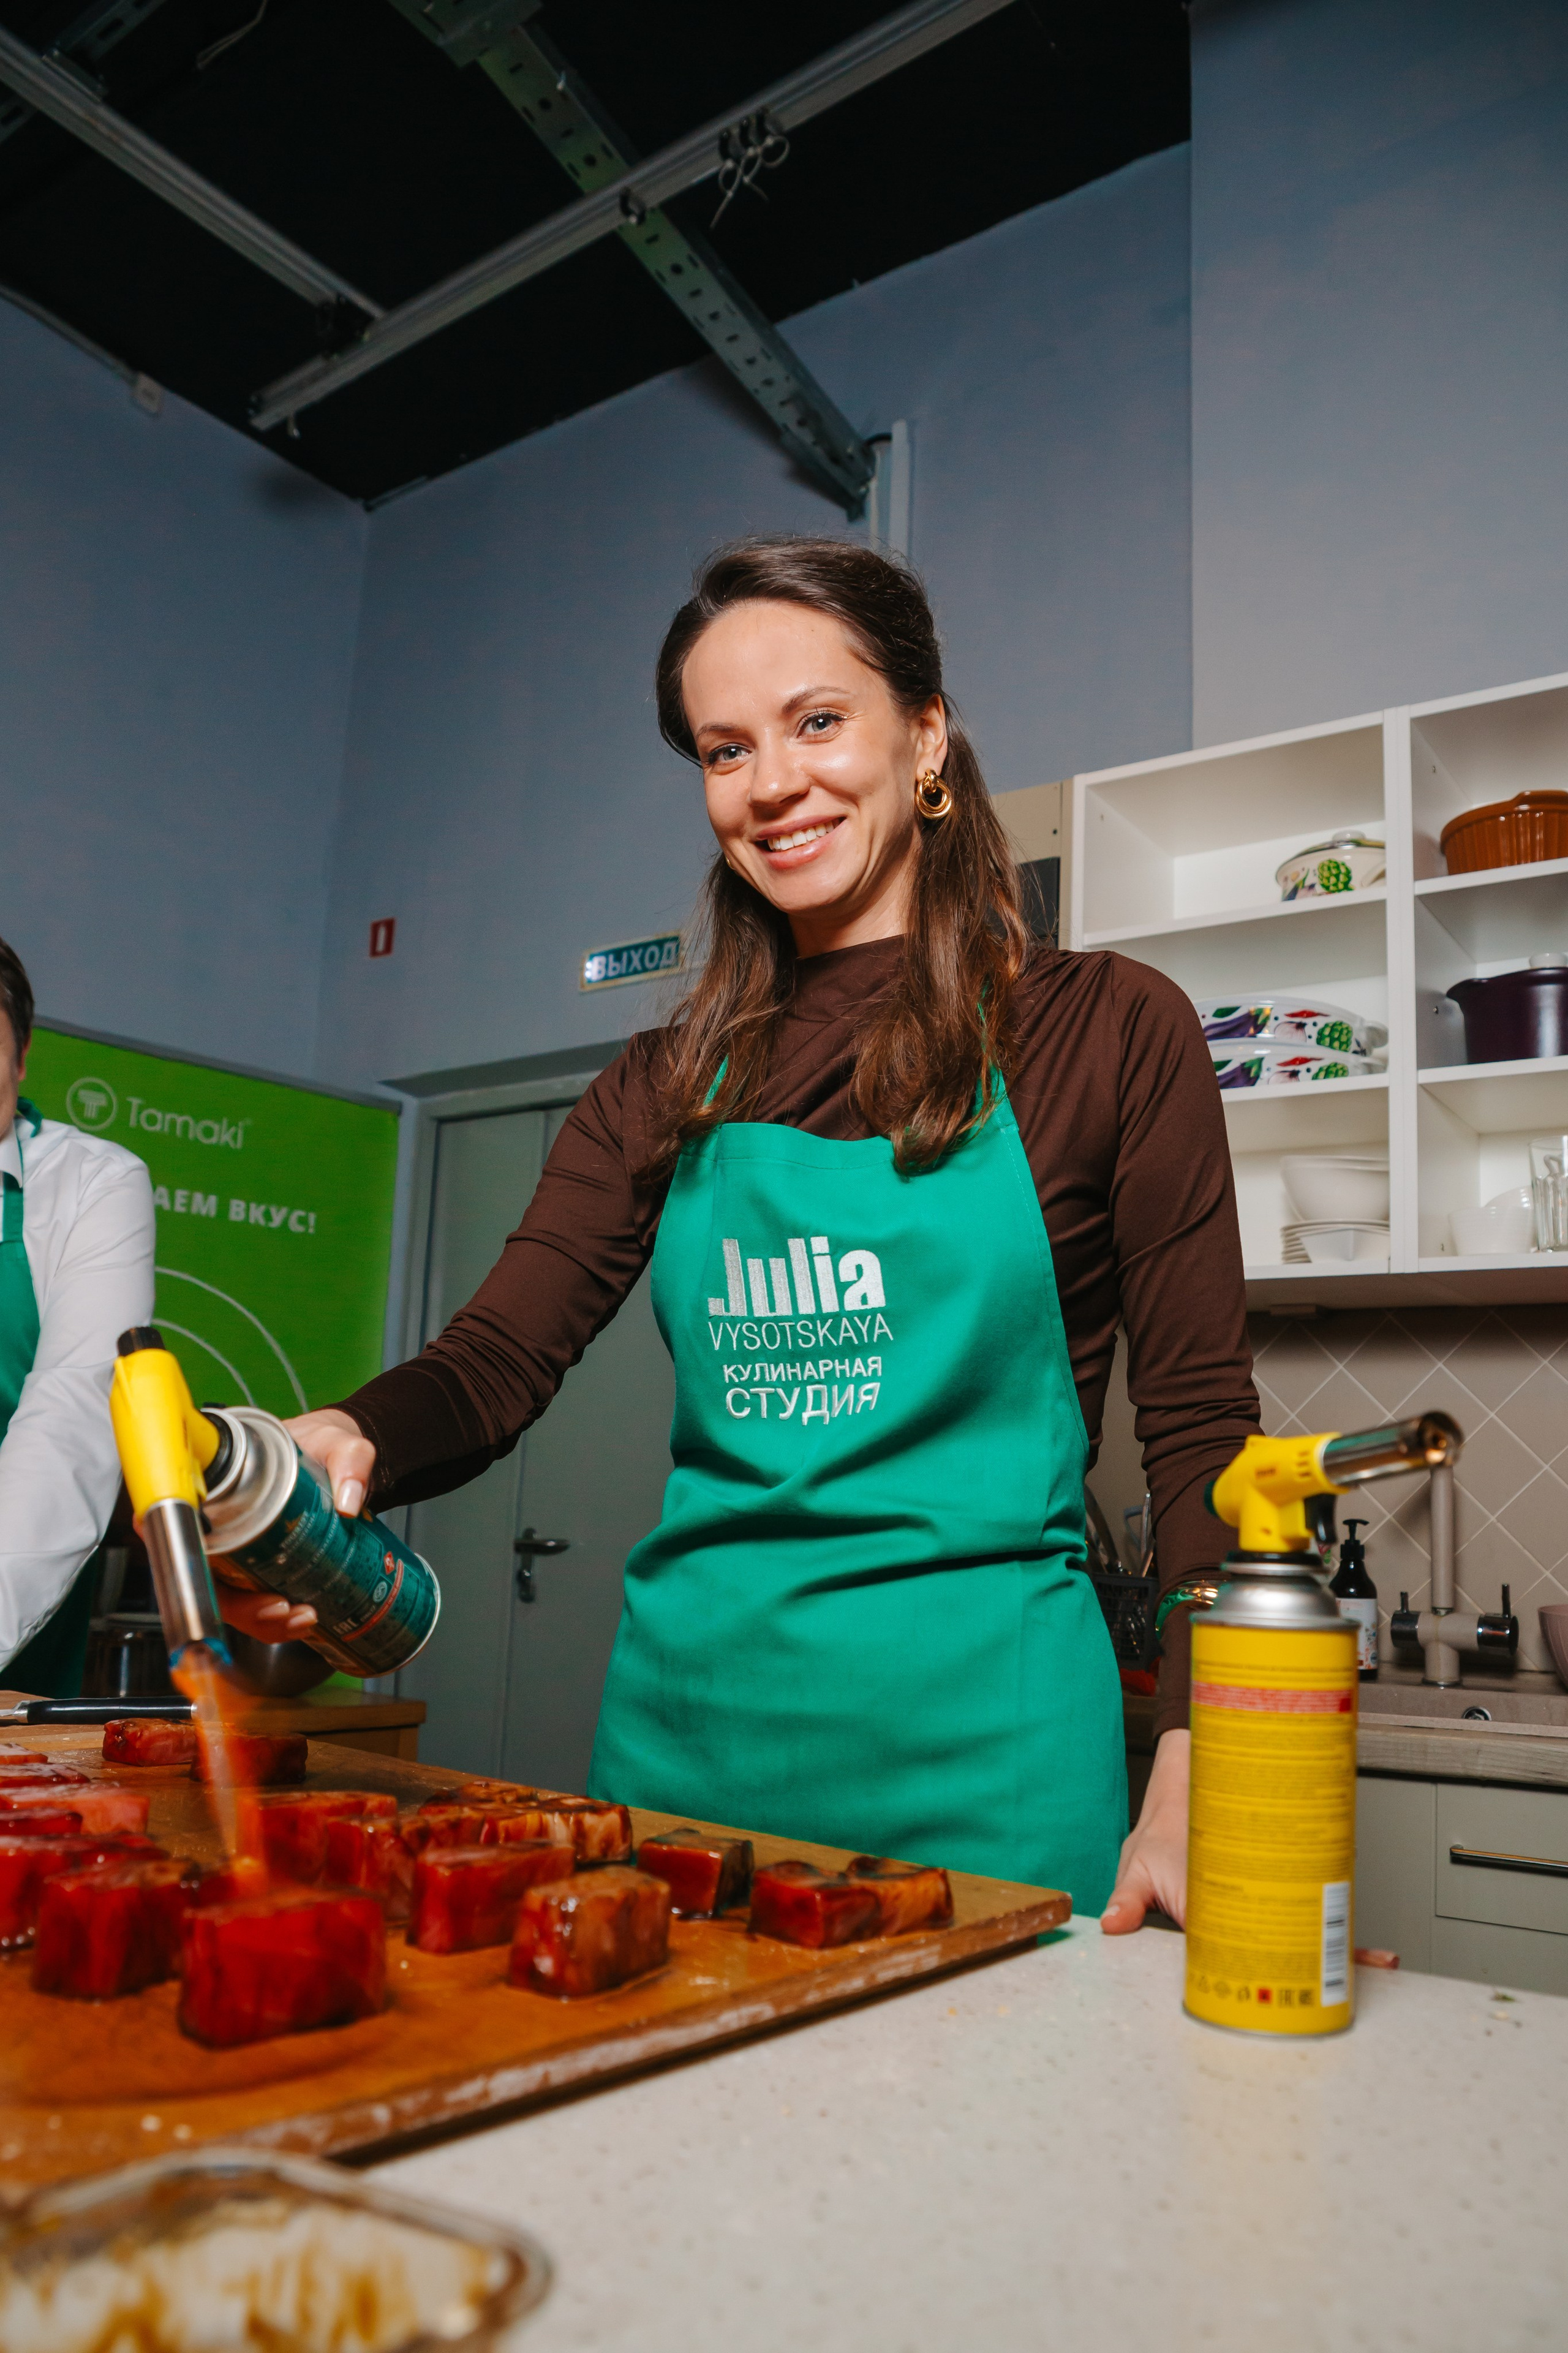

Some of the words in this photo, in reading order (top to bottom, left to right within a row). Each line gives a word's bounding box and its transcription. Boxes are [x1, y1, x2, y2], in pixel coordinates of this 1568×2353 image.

[590, 941, 677, 981] ВЫХОД
[126, 1097, 244, 1149] Tamaki
[153, 1185, 217, 1218] АЕМ
[228, 1199, 317, 1234] ВКУС!
[707, 1236, 886, 1317] Julia
[708, 1313, 894, 1351] VYSOTSKAYA
[723, 1356, 882, 1383] КУЛИНАРНАЯ
[726, 1383, 881, 1426] СТУДИЯ
